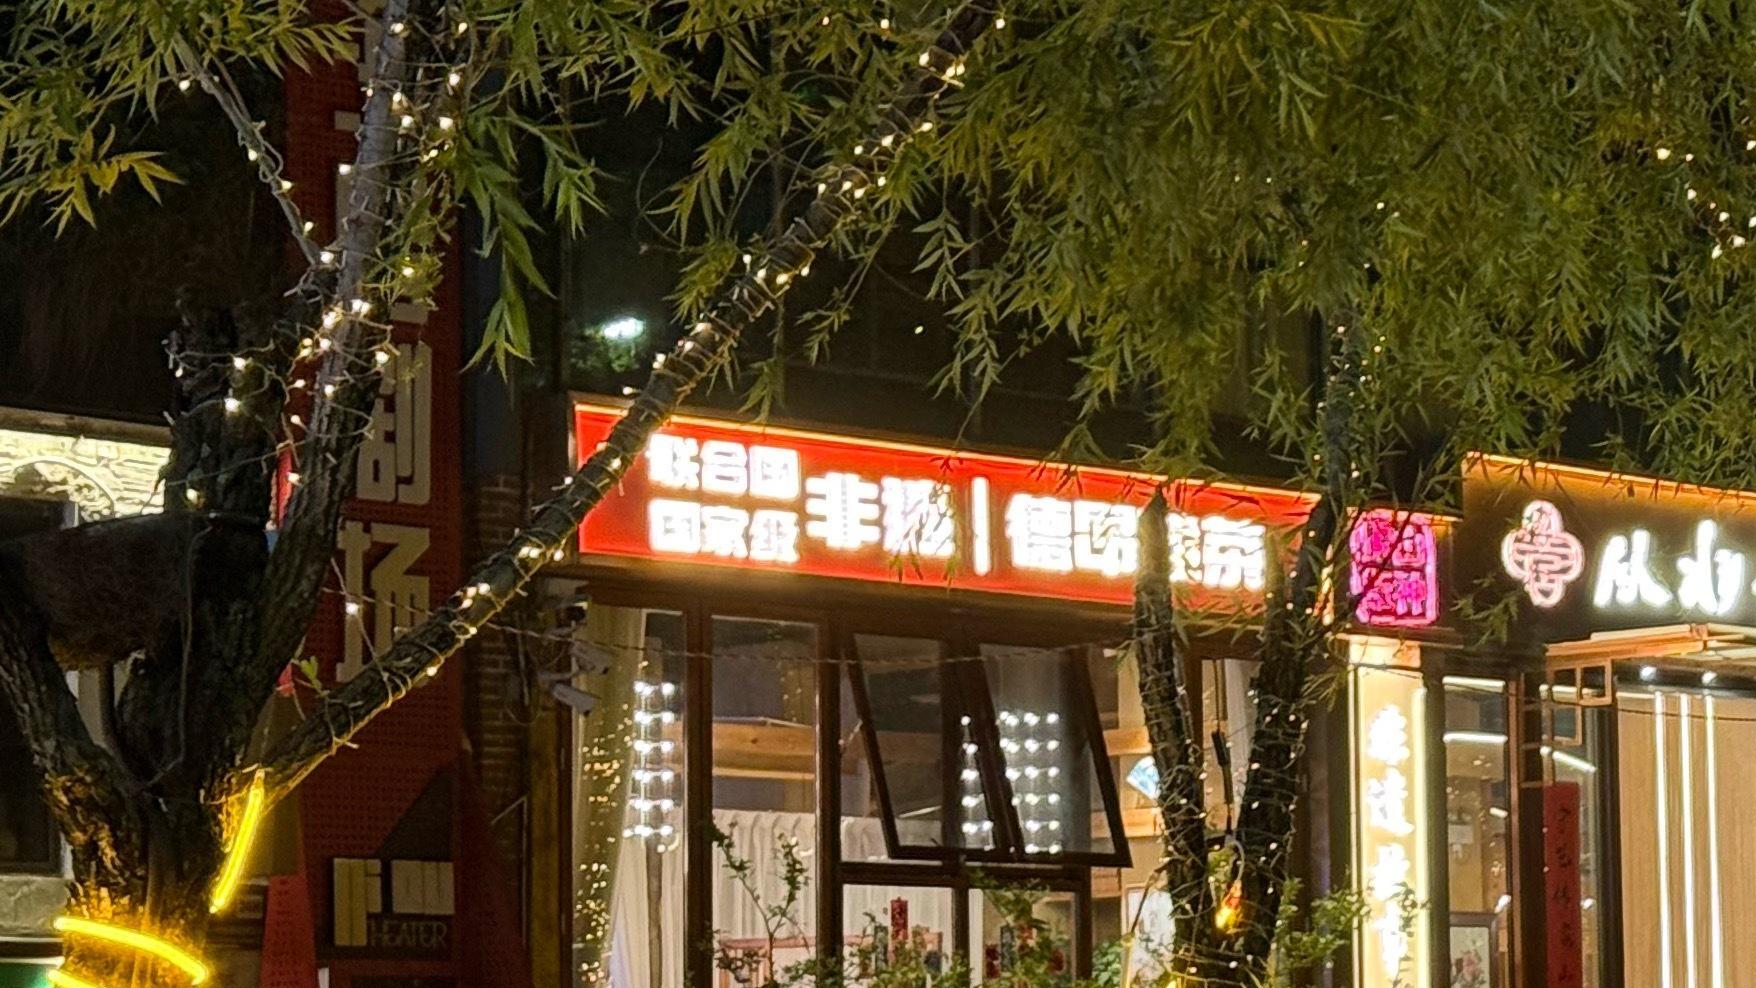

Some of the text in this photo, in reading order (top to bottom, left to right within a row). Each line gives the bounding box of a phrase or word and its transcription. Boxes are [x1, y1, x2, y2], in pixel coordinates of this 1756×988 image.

[648, 433, 800, 500] 联合国
[649, 499, 800, 563] 国家级
